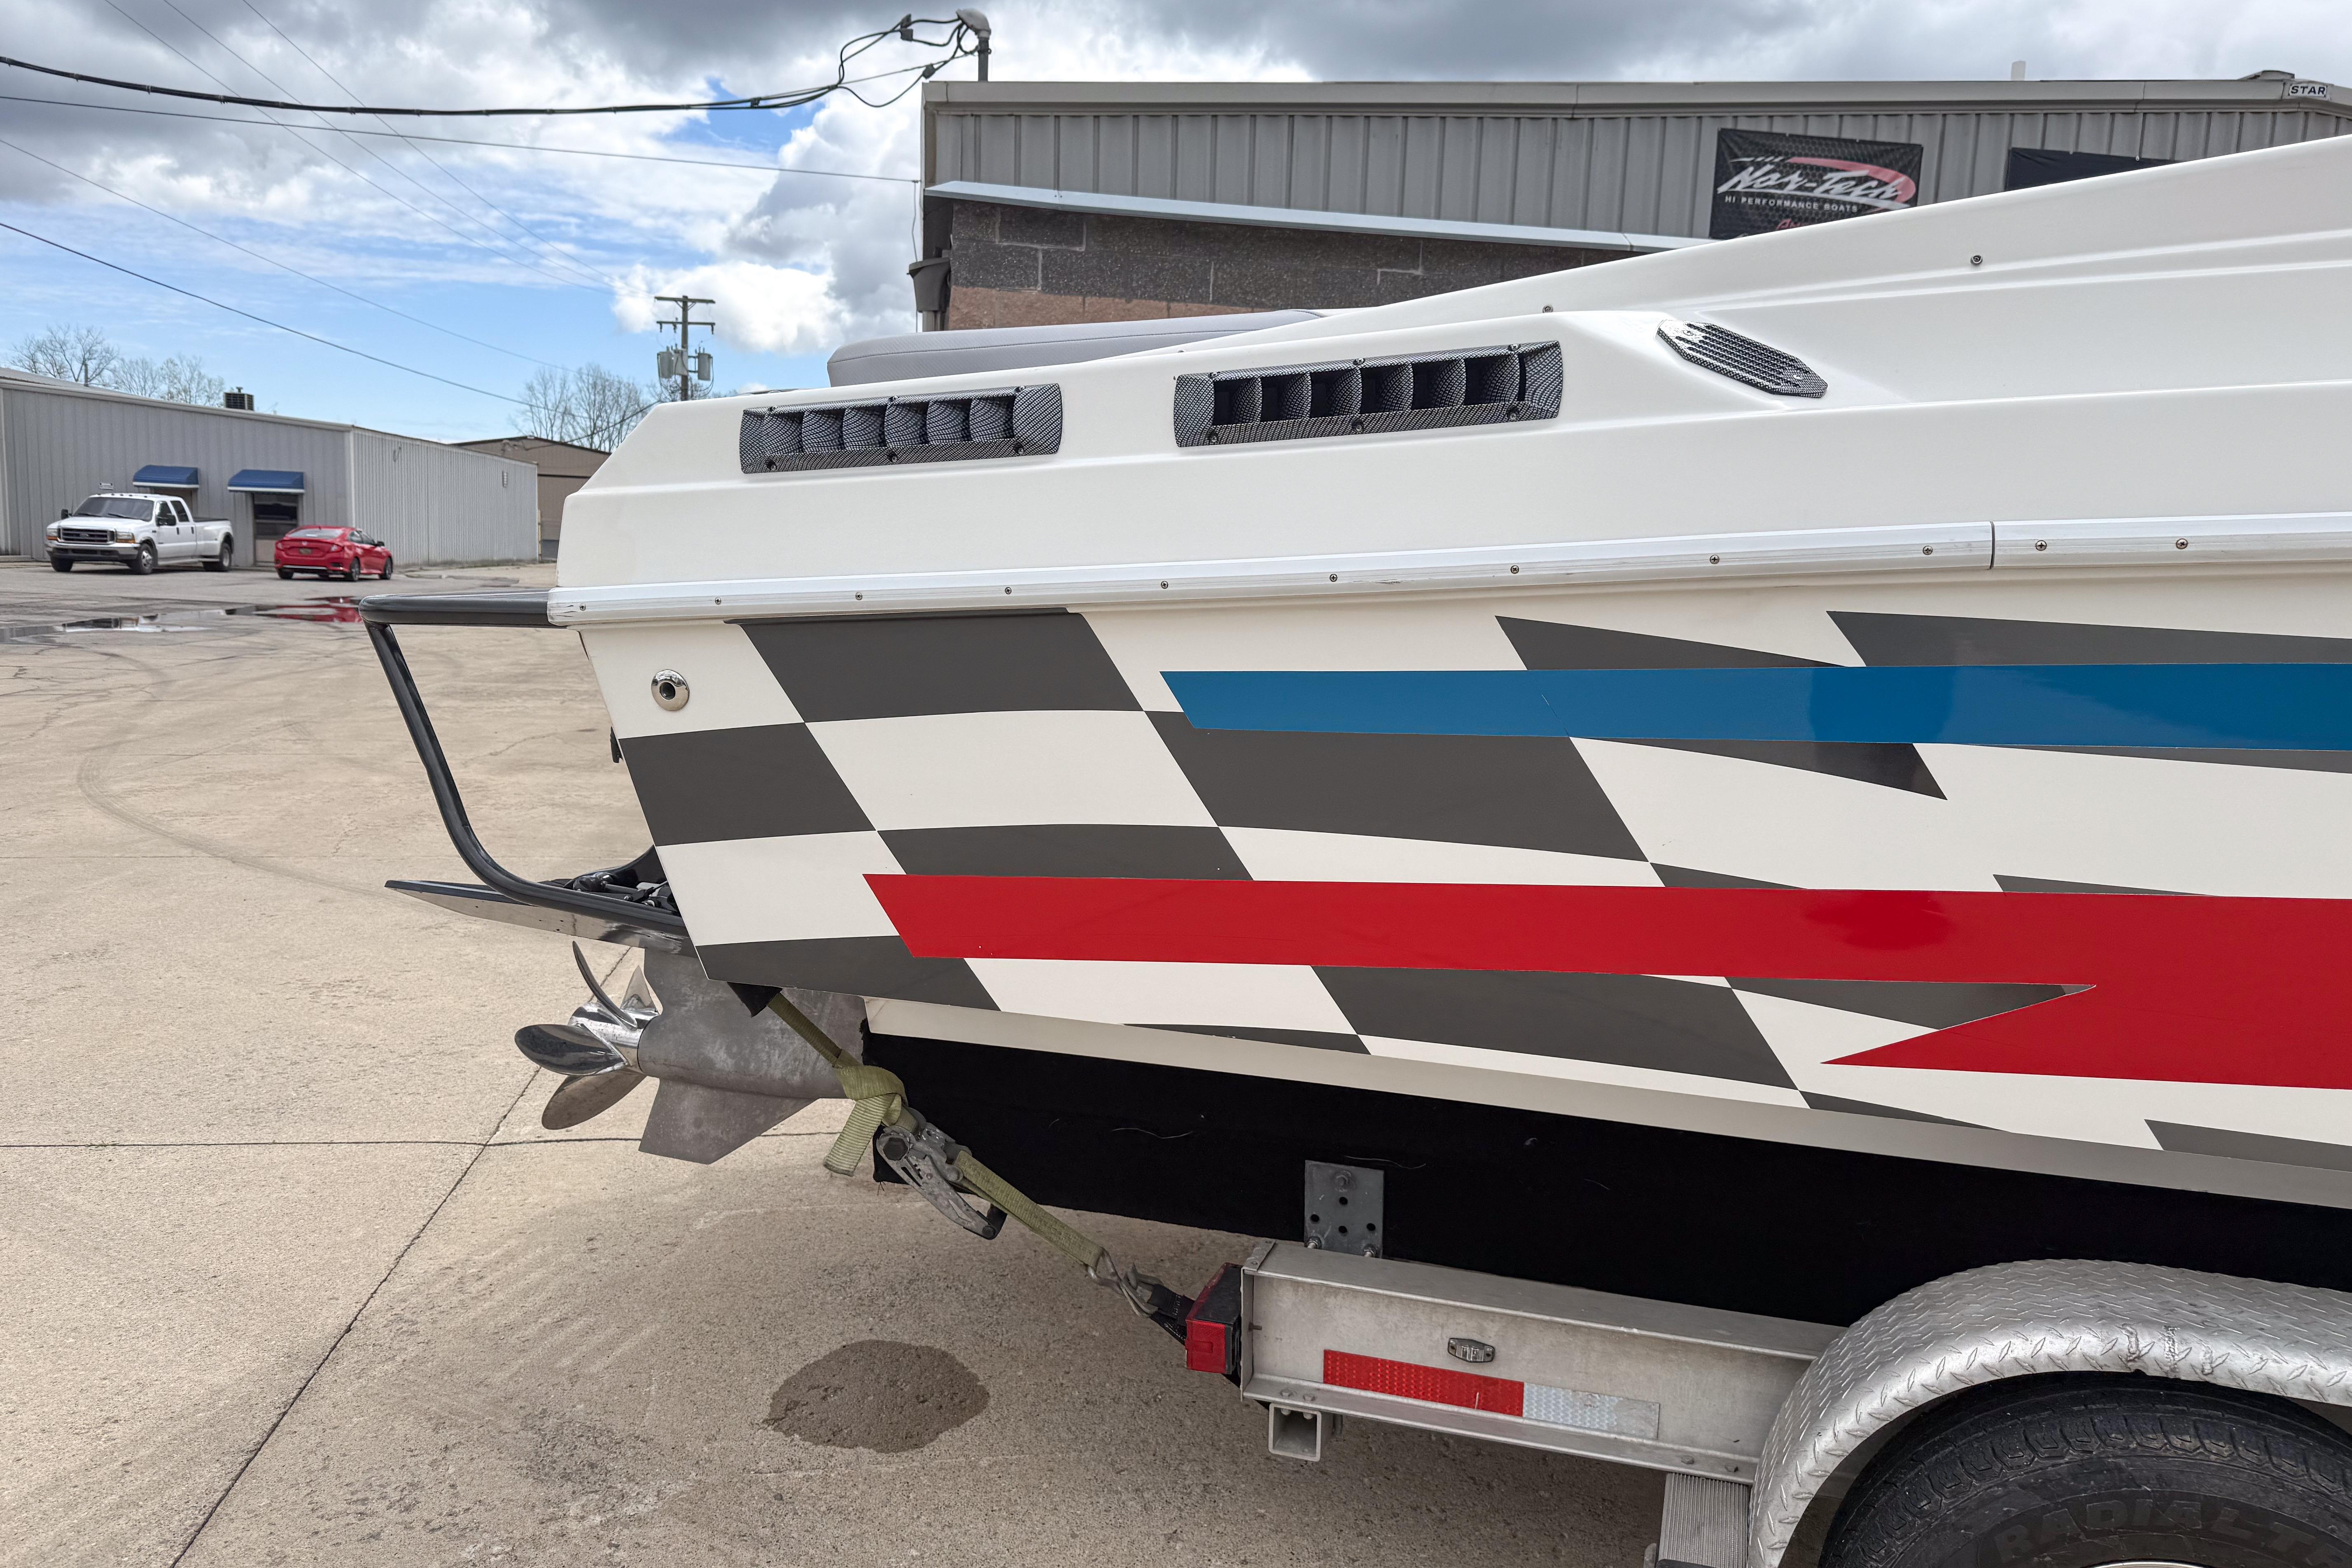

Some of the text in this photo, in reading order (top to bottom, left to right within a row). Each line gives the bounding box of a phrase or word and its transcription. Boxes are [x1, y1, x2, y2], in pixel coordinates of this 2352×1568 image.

[2291, 85, 2326, 95] STAR
[1717, 164, 1906, 199] Nor-Tech
[1741, 196, 1819, 210] PERFORMANCE
[1824, 202, 1858, 213] BOATS
[1994, 1498, 2254, 1563] RADIAL
